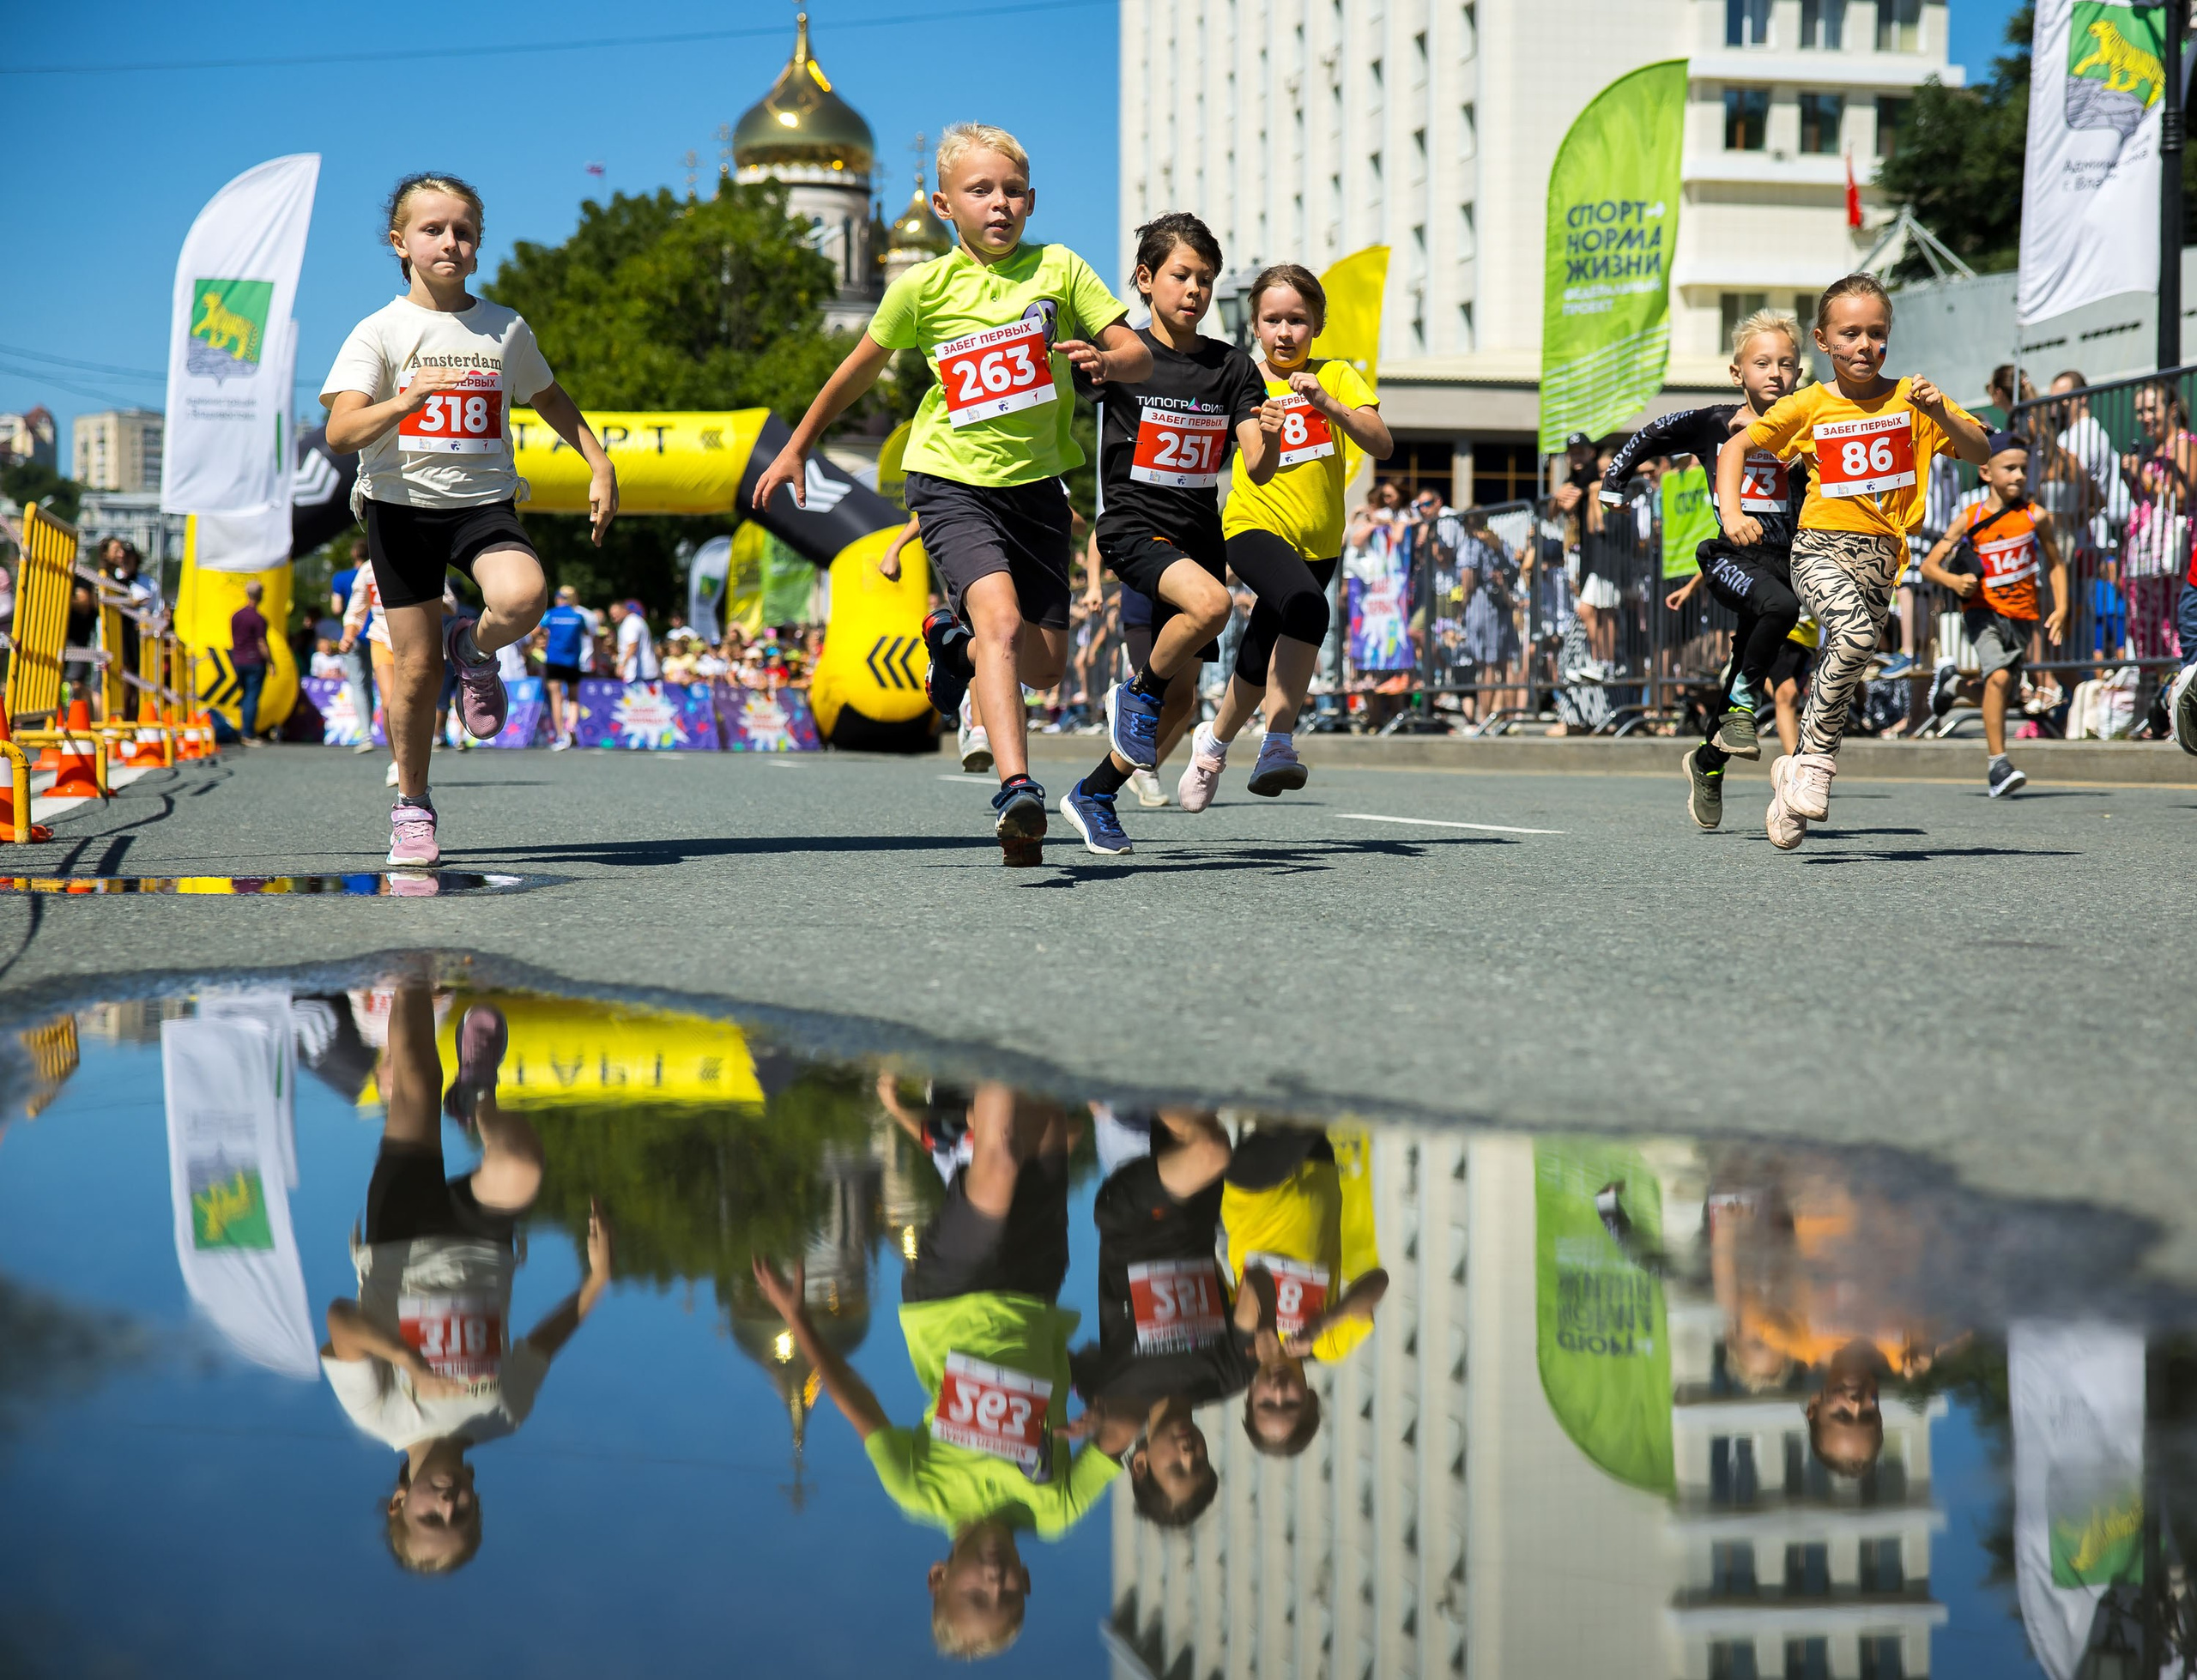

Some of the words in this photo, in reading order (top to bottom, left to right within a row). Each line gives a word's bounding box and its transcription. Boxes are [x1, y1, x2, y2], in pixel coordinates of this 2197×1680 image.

[1567, 199, 1647, 227] СПОРТ
[1566, 224, 1662, 255] НОРМА
[1566, 251, 1661, 283] ЖИЗНИ
[943, 337, 977, 355] ЗАБЕГ
[979, 323, 1032, 344] ПЕРВЫХ
[411, 353, 502, 371] Amsterdam
[952, 344, 1036, 402] 263
[418, 396, 488, 433] 318
[1151, 412, 1187, 425] ЗАБЕГ
[1188, 418, 1224, 427] ПЕРВЫХ
[1823, 425, 1857, 436] ЗАБЕГ
[1861, 417, 1903, 432] ПЕРВЫХ
[1153, 432, 1213, 468] 251
[1842, 437, 1893, 476] 86
[1741, 466, 1776, 496] 73
[1988, 545, 2031, 574] 144
